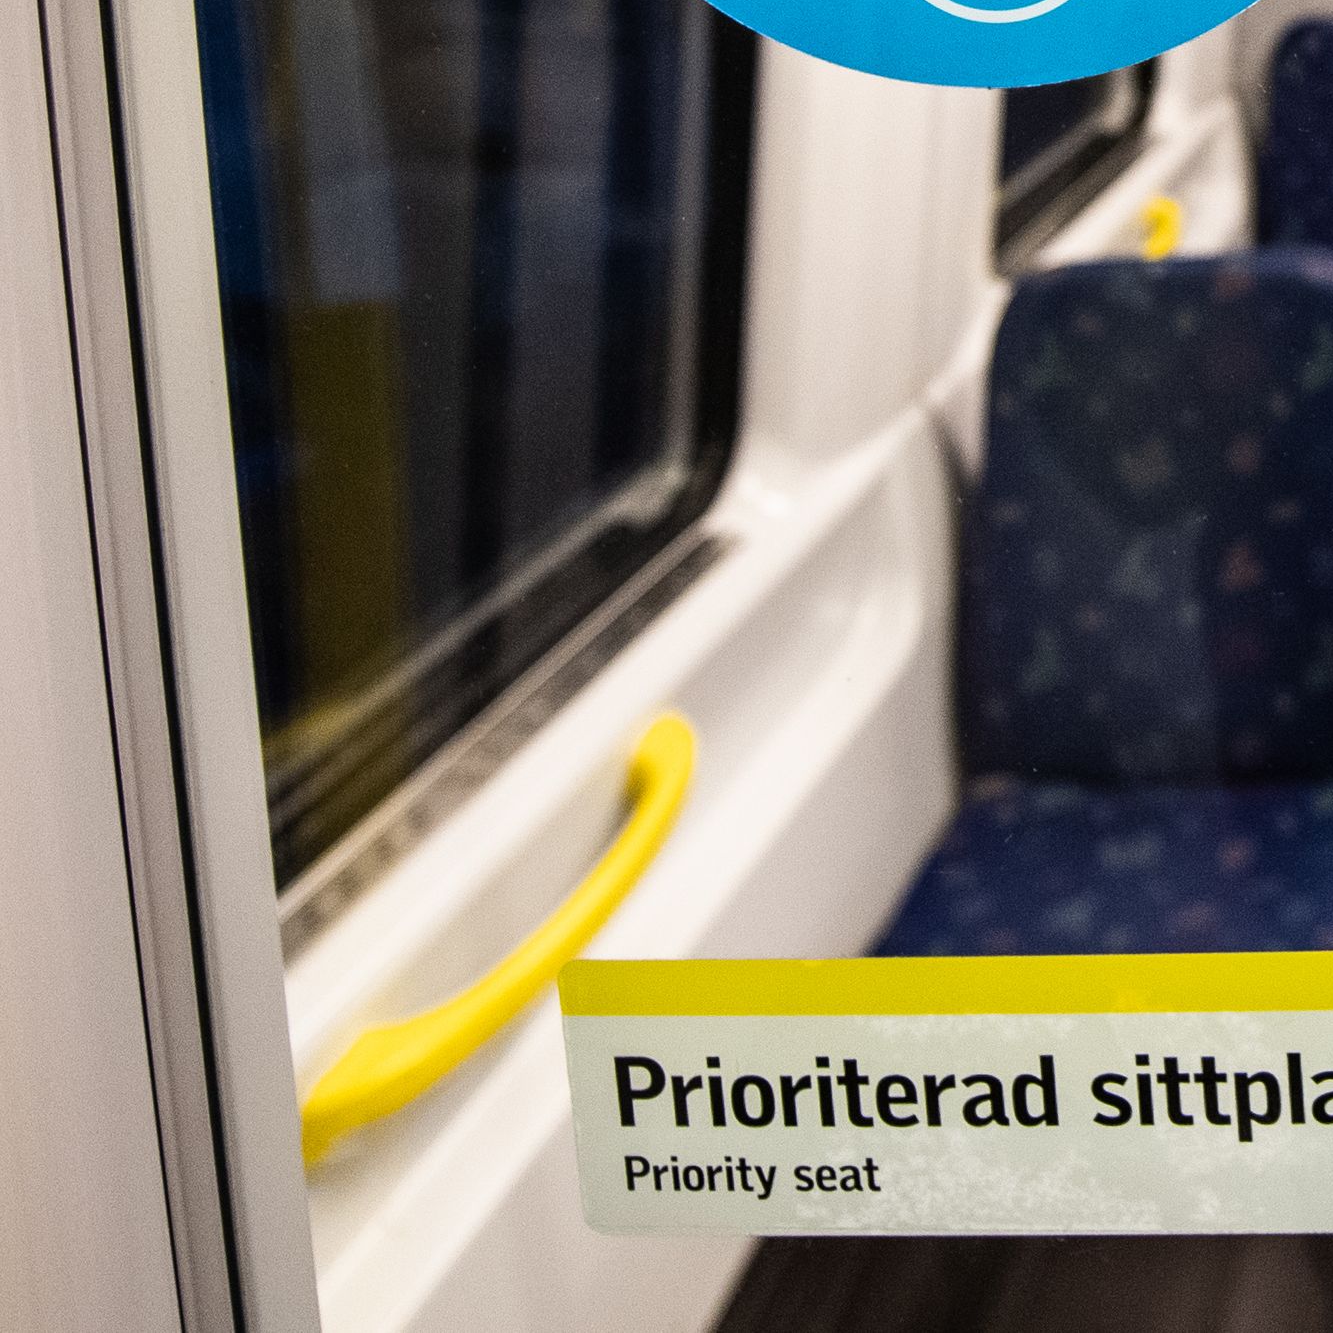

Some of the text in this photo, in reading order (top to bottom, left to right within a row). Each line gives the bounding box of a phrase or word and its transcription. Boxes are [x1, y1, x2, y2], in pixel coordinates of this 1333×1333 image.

[613, 1054, 1059, 1128] Prioriterad
[624, 1155, 882, 1200] Priority seat
